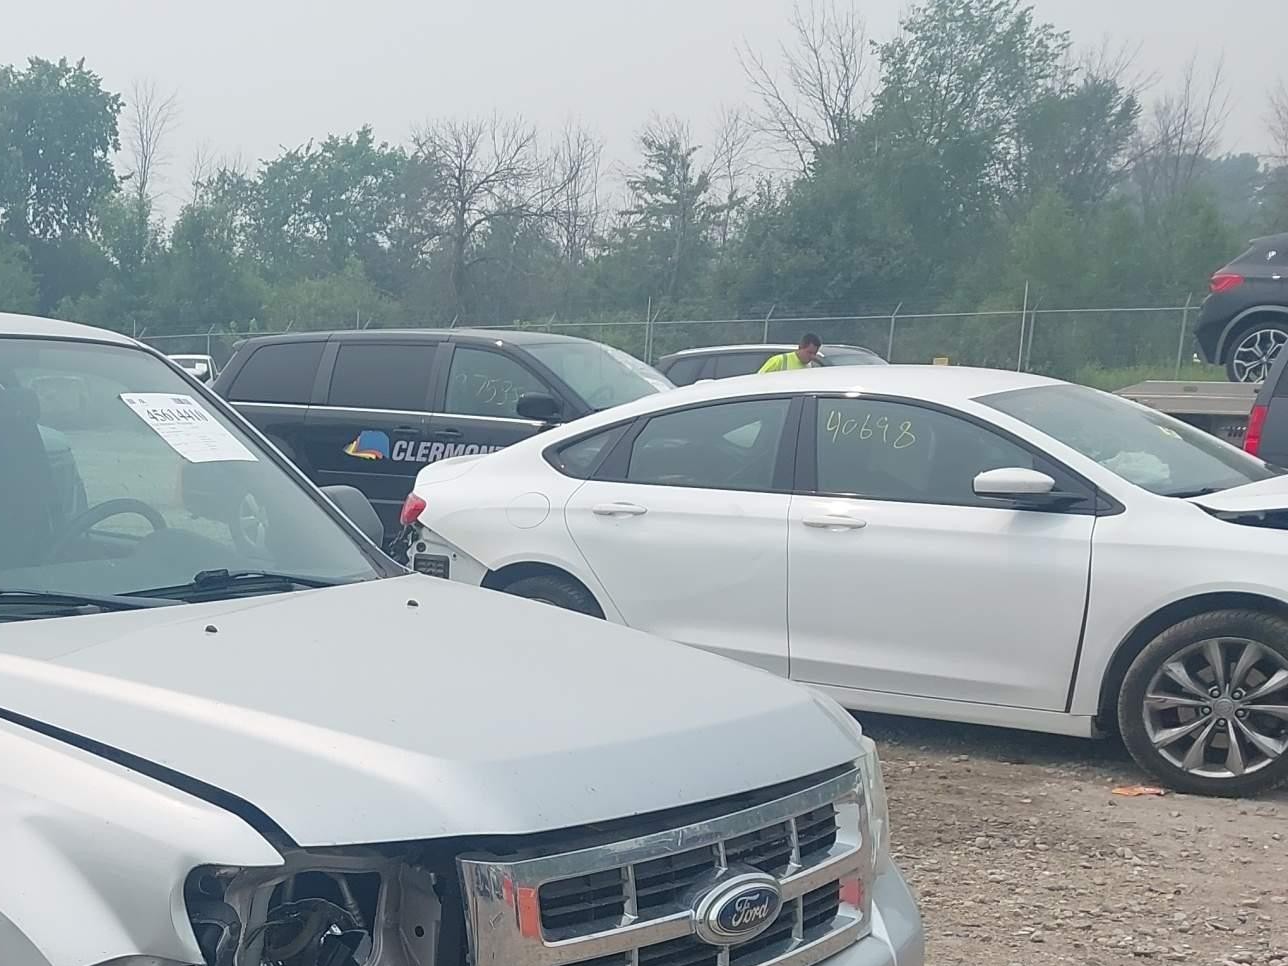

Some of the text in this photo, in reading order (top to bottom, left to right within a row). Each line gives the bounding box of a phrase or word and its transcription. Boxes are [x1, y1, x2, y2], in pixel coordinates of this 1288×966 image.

[146, 408, 209, 422] 45614410
[826, 409, 916, 449] 40698
[391, 440, 505, 463] CLERMO
[732, 893, 769, 927] Ford
